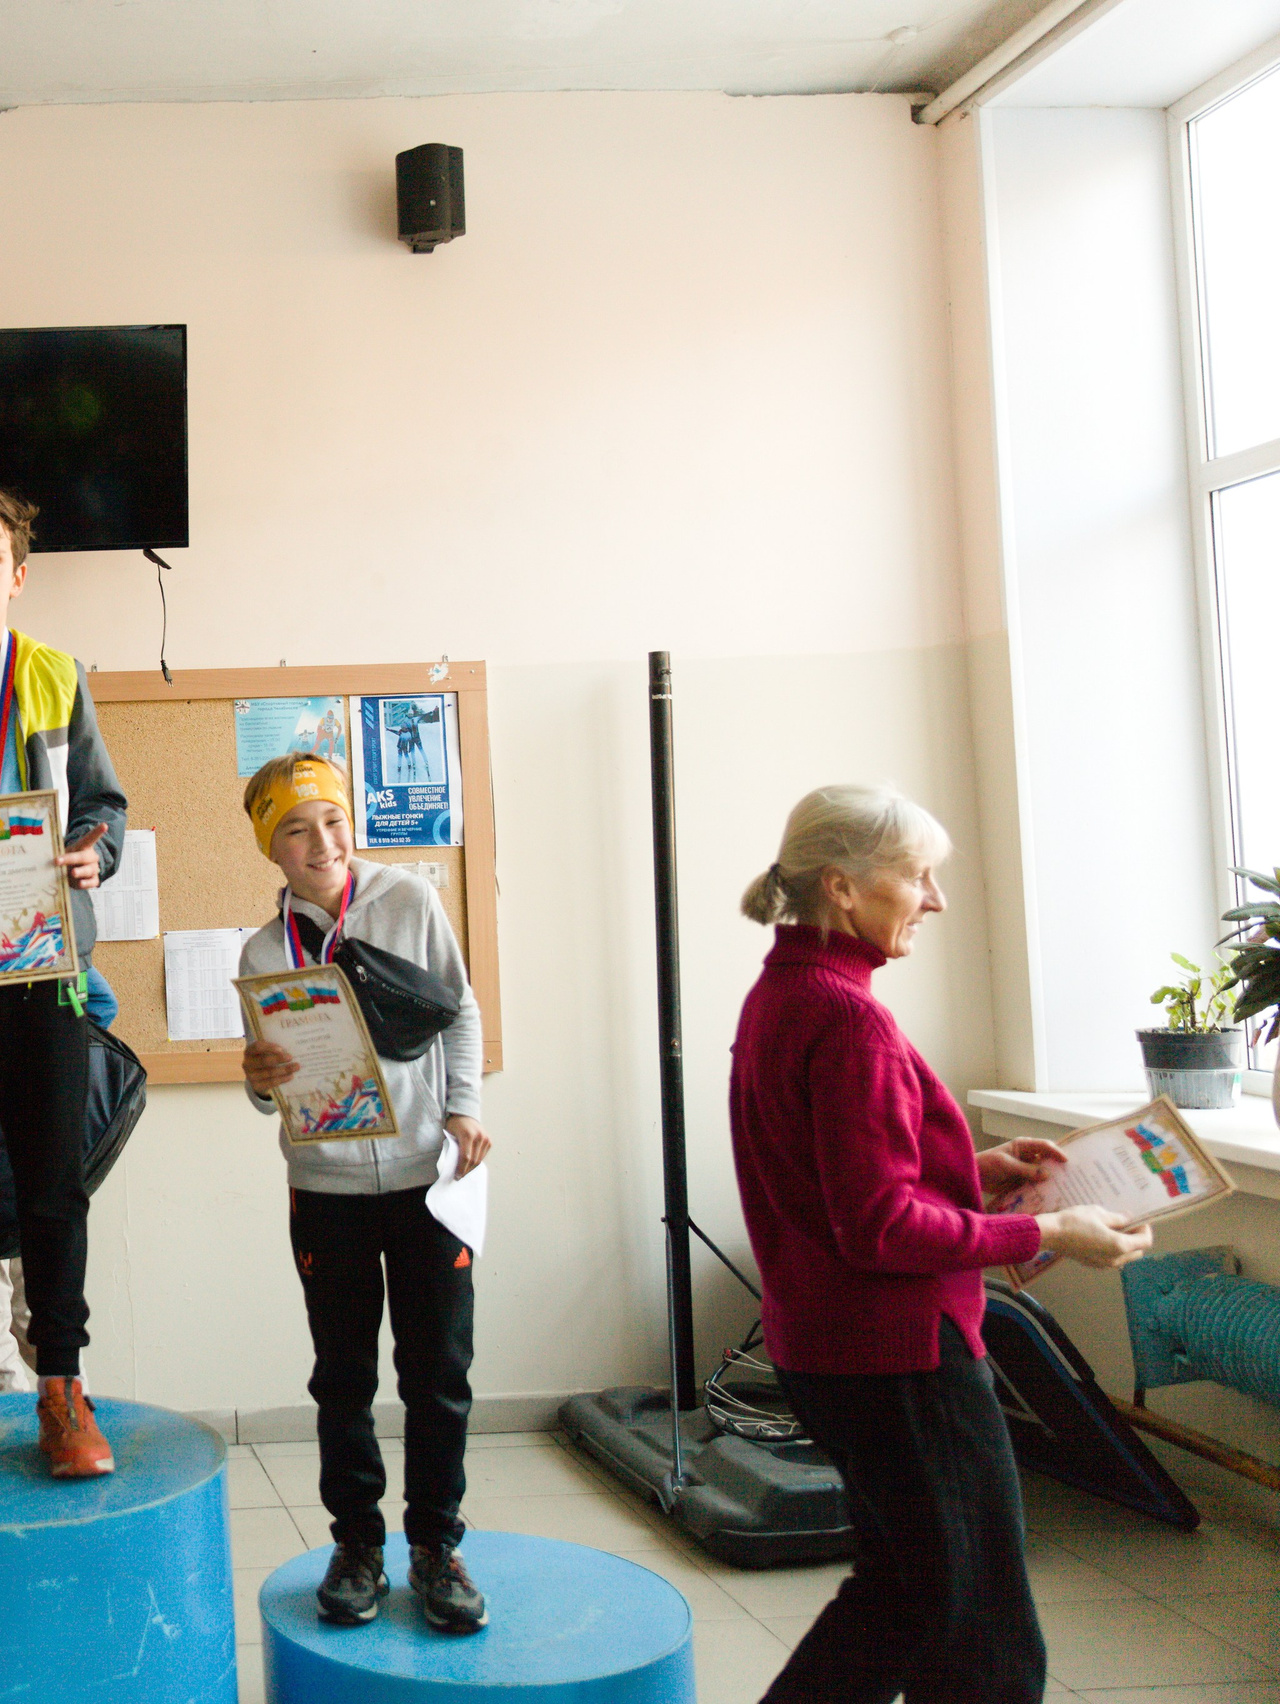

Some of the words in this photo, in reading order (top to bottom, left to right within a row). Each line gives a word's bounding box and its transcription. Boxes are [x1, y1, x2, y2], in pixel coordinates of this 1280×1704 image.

[367, 789, 394, 804] AKS
[408, 795, 442, 803] УВЛЕЧЕНИЕ
[380, 800, 397, 809] kids
[409, 802, 449, 811] ОБЪЕДИНЯЕТ!
[389, 819, 410, 827] ДЕТЕЙ
